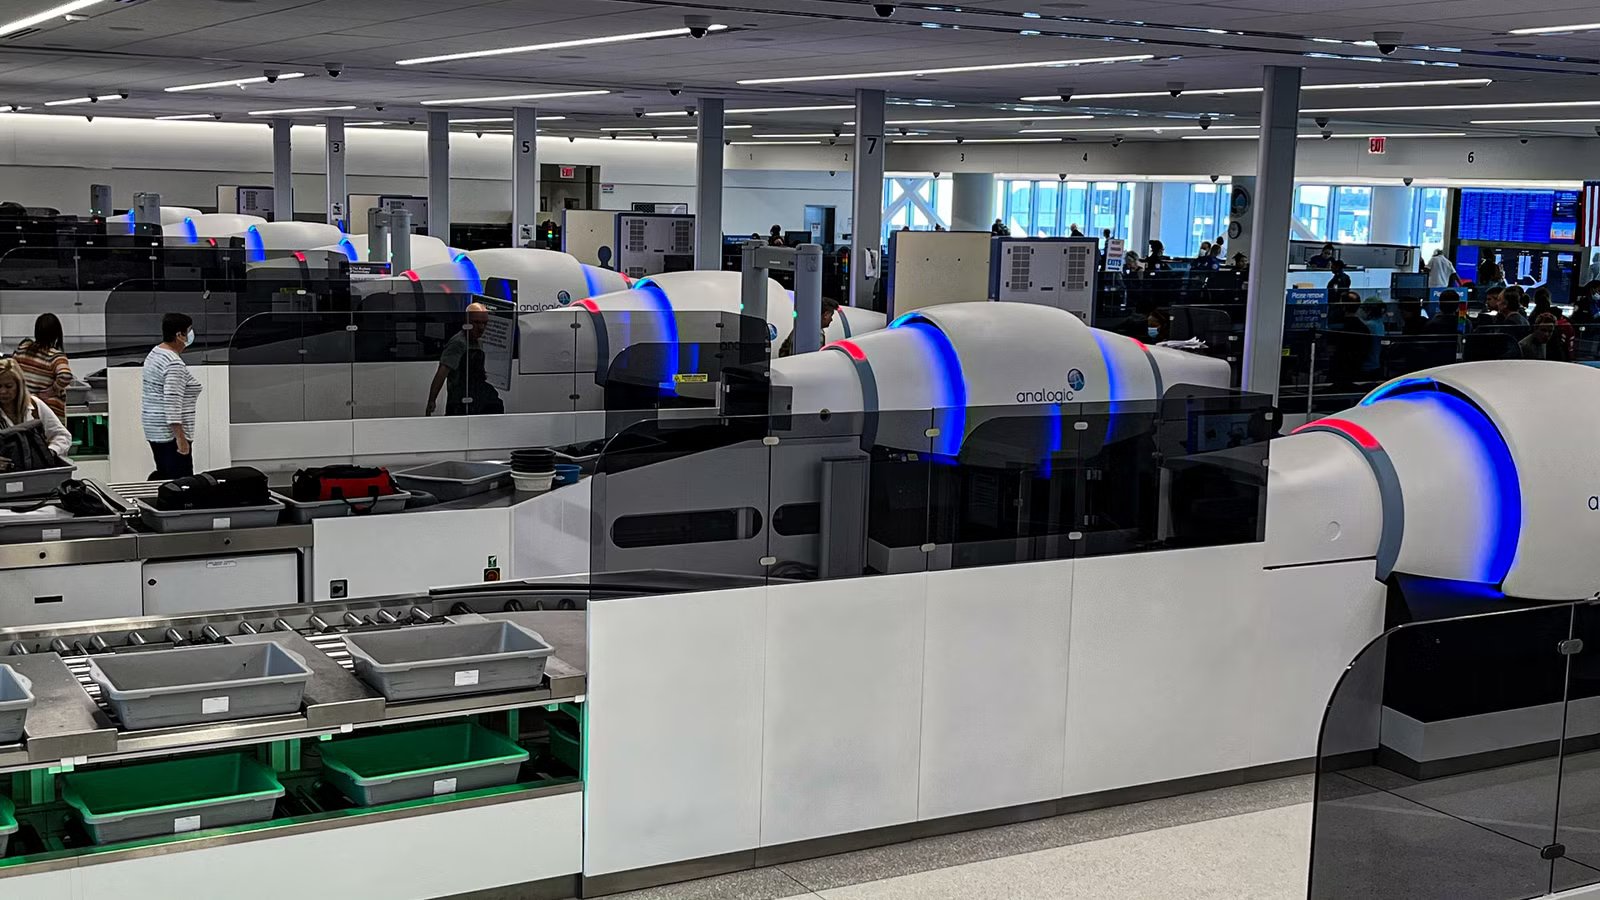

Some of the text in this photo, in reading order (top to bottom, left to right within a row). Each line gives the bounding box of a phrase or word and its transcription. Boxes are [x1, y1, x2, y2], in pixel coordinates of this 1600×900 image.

[333, 142, 340, 153] 3
[522, 140, 530, 153] 5
[866, 138, 877, 154] 7
[844, 153, 849, 161] 2
[960, 153, 965, 162] 3
[1082, 152, 1088, 161] 4
[1468, 151, 1474, 163] 6
[1016, 388, 1074, 405] analogic
